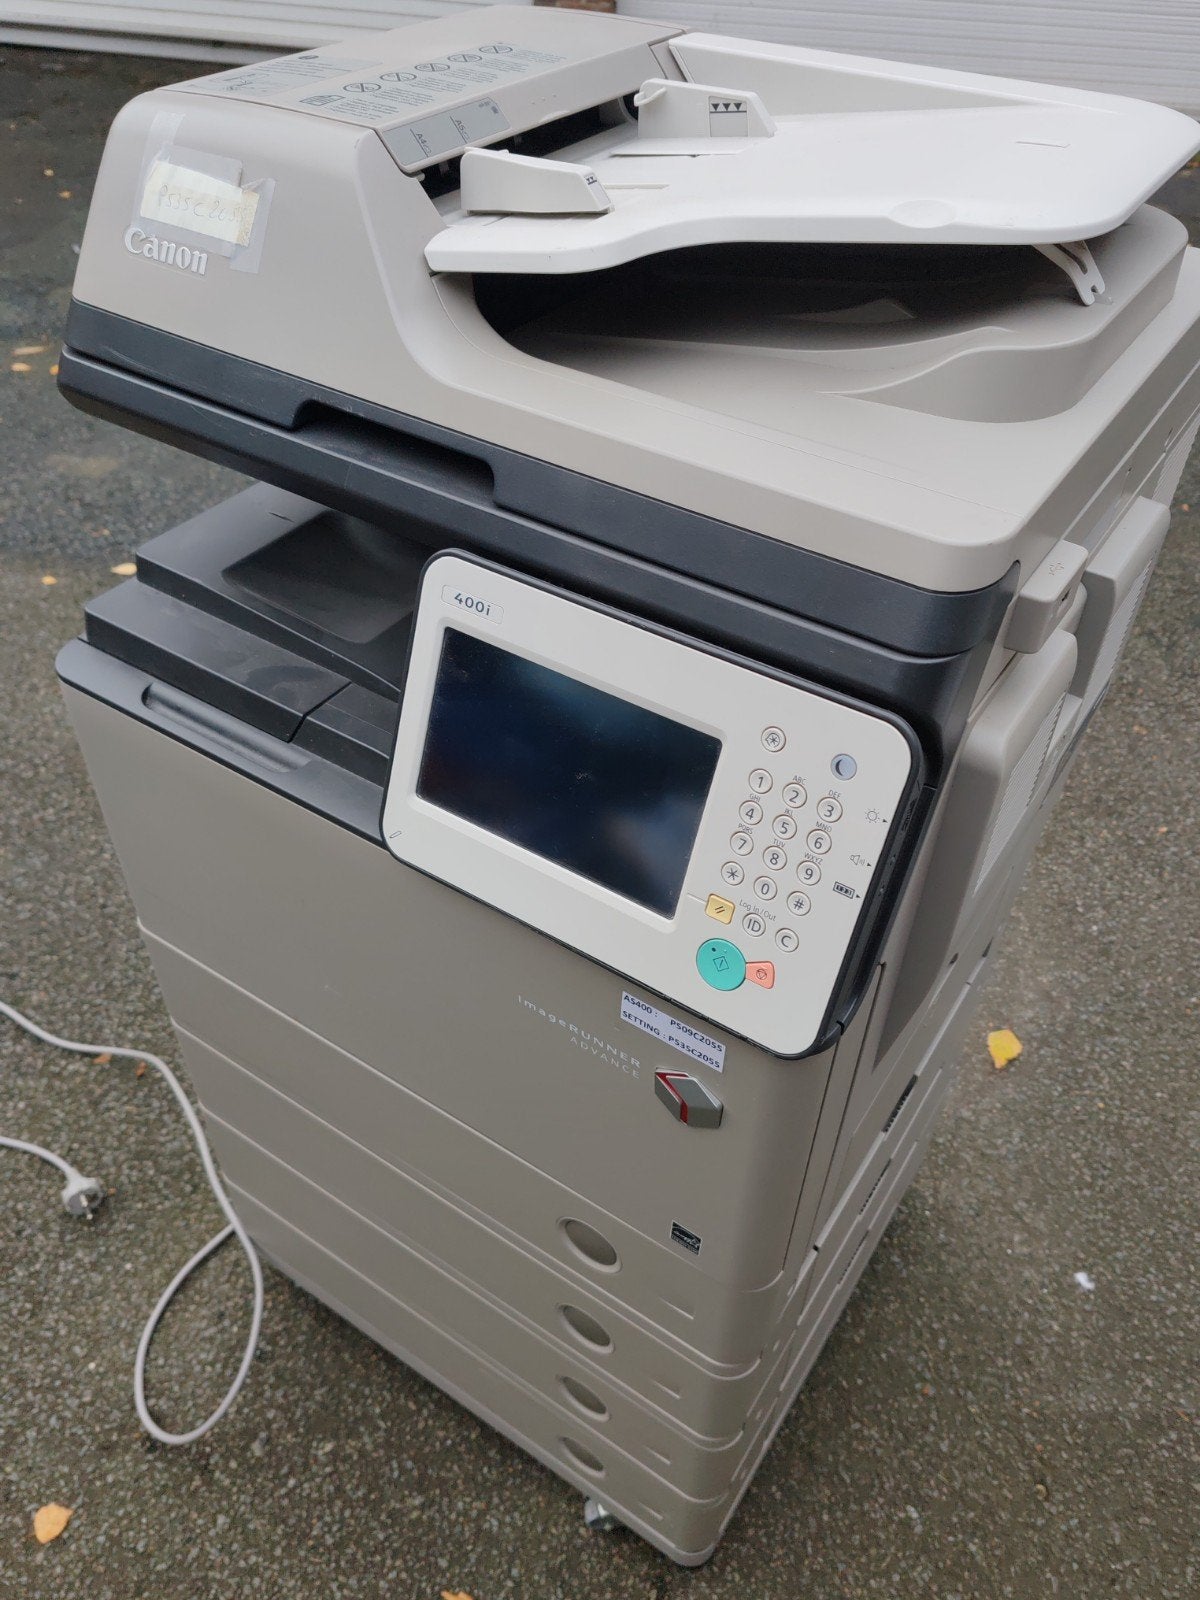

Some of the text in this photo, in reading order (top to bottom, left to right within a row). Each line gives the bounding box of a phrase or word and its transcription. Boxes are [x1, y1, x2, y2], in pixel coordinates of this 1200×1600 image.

[416, 132, 427, 145] A4
[124, 227, 208, 276] Canon
[454, 592, 491, 616] 400i
[758, 776, 764, 789] 1
[792, 775, 806, 785] ABC
[788, 789, 800, 804] 2
[828, 790, 842, 799] DEF
[745, 808, 755, 820] 4
[823, 804, 835, 818] 3
[737, 822, 754, 835] PQRS
[779, 821, 790, 835] 5
[815, 821, 832, 833] MNO
[738, 838, 747, 850] 7
[773, 838, 786, 848] TUV
[814, 837, 824, 850] 6
[769, 852, 780, 866] 8
[804, 852, 823, 865] WXYZ
[803, 867, 814, 880] 9
[739, 899, 752, 912] Log
[747, 918, 762, 933] ID
[781, 935, 792, 948] C
[622, 1009, 660, 1036] SETTING
[668, 1034, 721, 1069] P535C2055
[669, 1018, 724, 1052] P509C2055
[569, 1036, 641, 1080] ADVANCE
